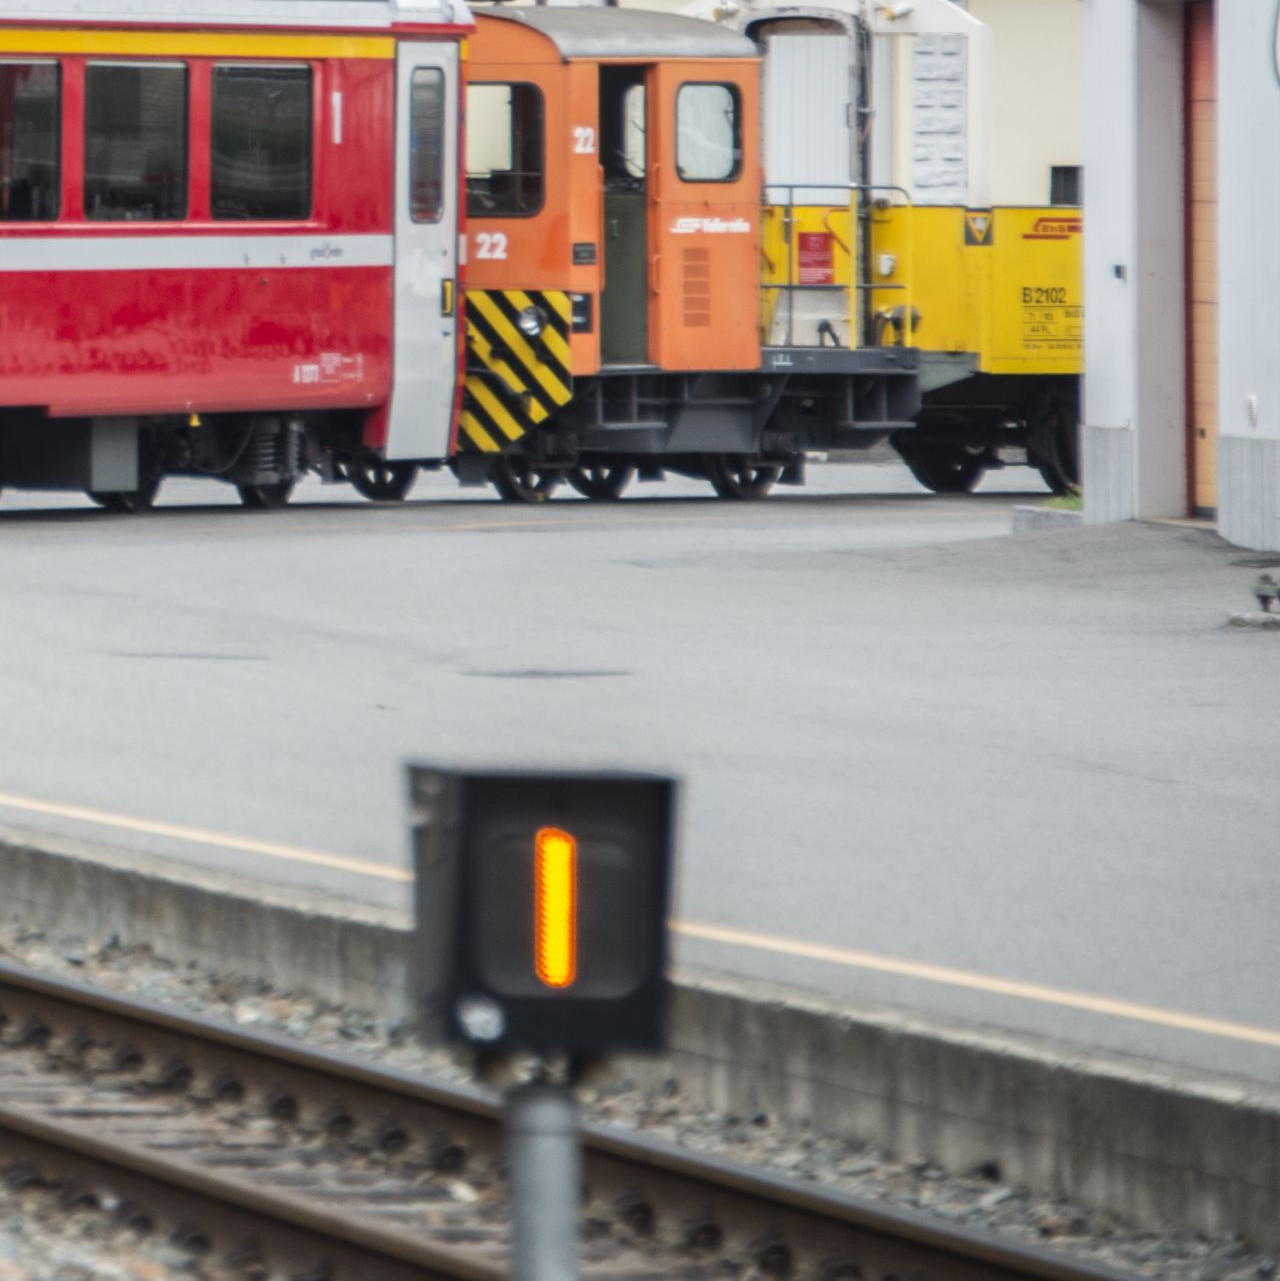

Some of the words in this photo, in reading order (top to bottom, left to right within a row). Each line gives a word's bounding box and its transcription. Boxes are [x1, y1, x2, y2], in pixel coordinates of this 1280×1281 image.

[331, 92, 342, 145] 1
[573, 126, 595, 154] 22
[475, 232, 508, 260] 22
